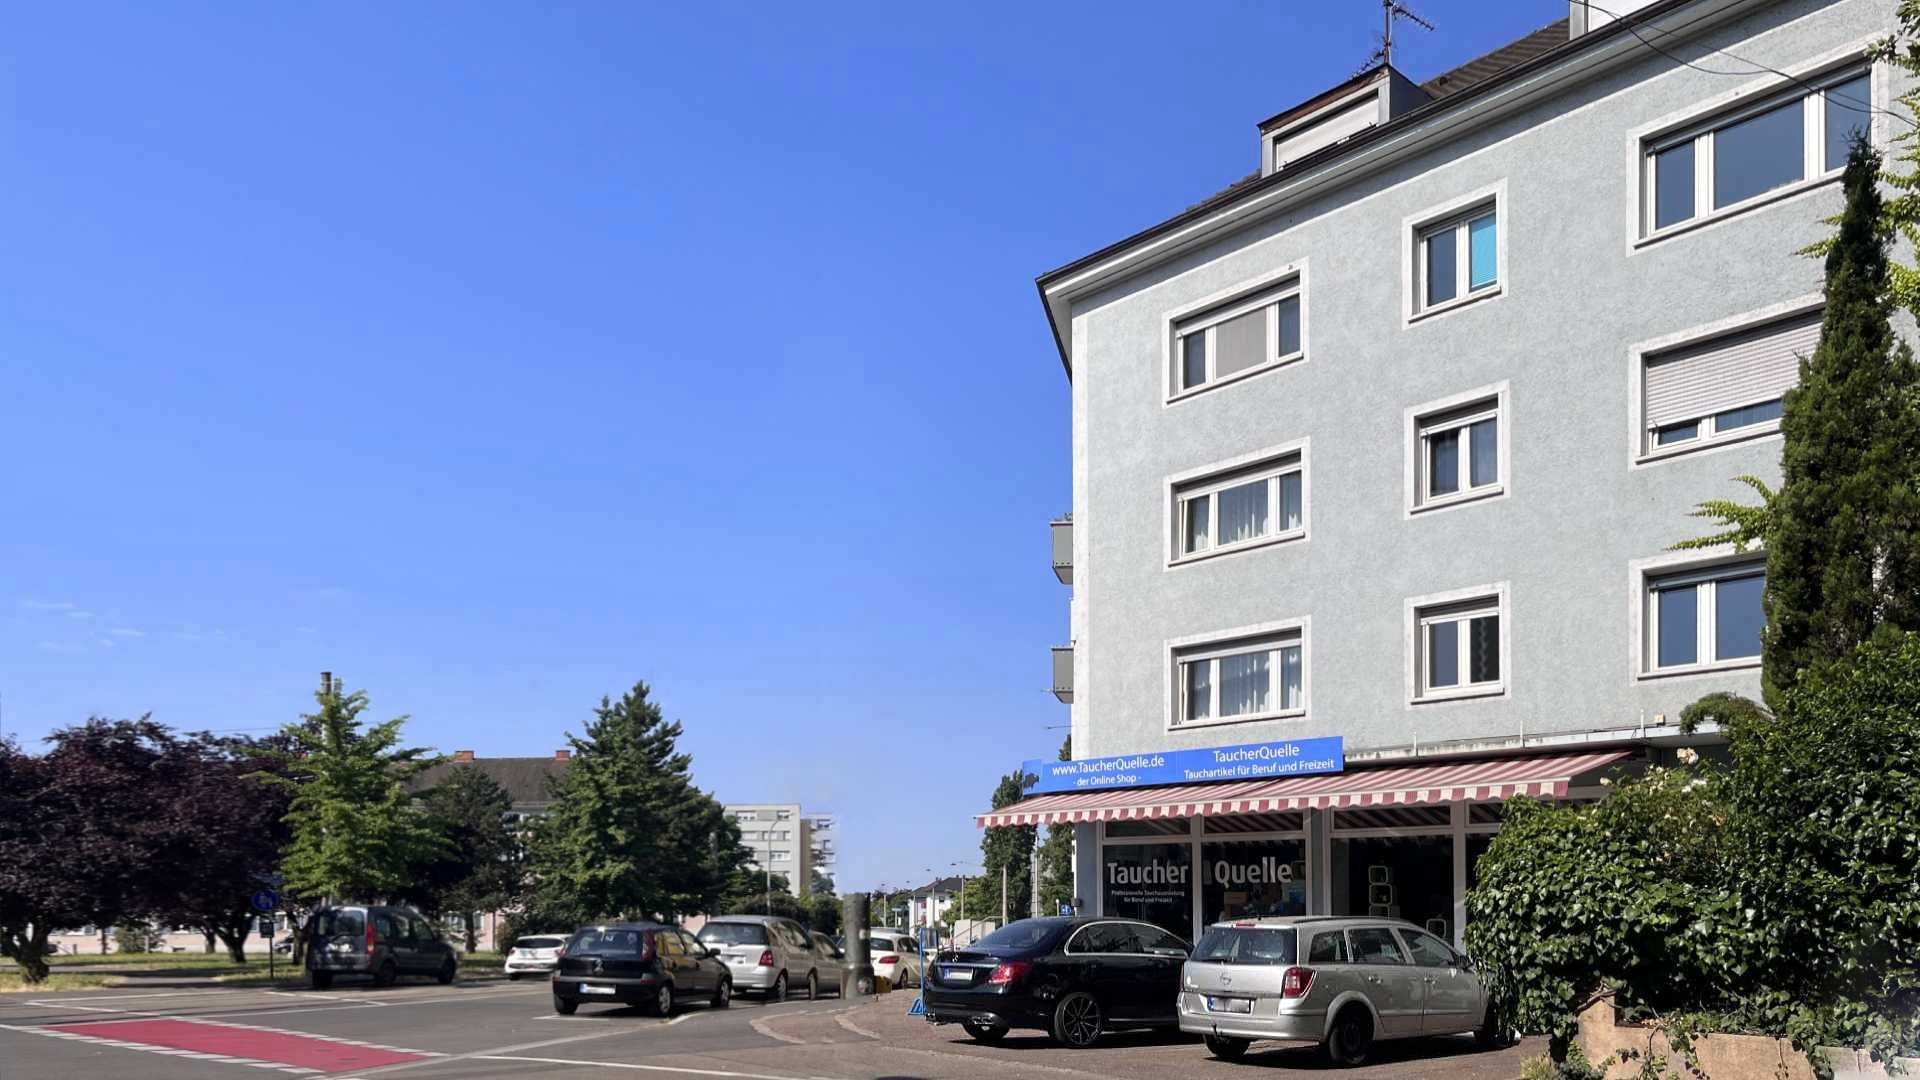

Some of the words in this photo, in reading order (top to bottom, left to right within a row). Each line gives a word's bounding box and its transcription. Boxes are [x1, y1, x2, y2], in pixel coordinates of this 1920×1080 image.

[1213, 744, 1300, 763] TaucherQuelle
[1052, 755, 1165, 776] www.TaucherQuelle.de
[1184, 767, 1236, 779] Tauchartikel
[1237, 765, 1250, 776] für
[1252, 762, 1277, 774] Beruf
[1279, 760, 1298, 772] und
[1300, 758, 1335, 770] Freizeit
[1077, 778, 1089, 787] der
[1090, 775, 1115, 786] Online
[1116, 773, 1137, 785] Shop
[1107, 858, 1189, 884] Taucher
[1214, 856, 1293, 889] Quelle
